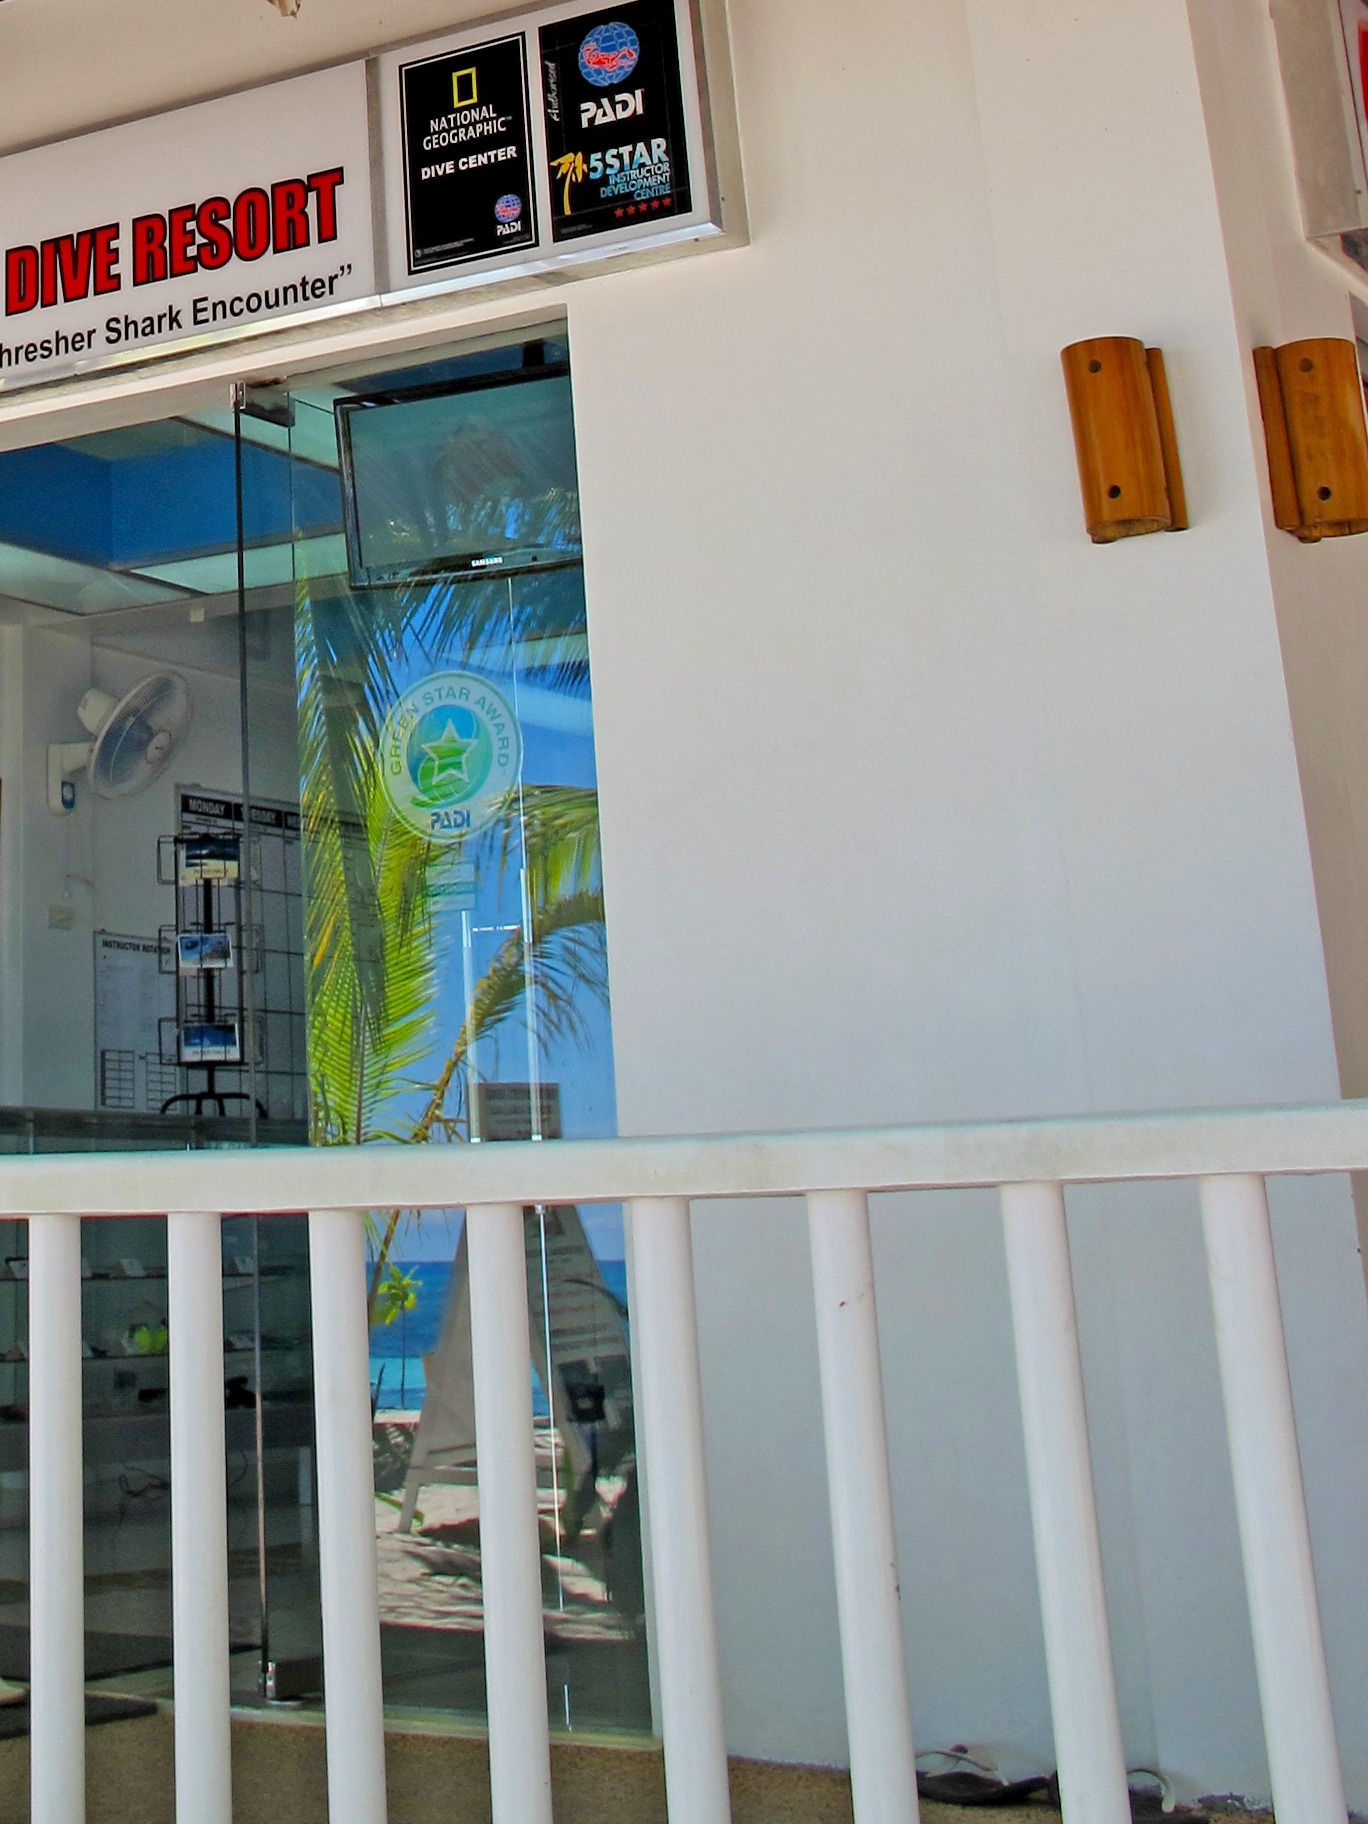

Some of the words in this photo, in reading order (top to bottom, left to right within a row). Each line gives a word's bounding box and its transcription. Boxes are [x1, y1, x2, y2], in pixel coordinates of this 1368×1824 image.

[429, 104, 497, 133] NATIONAL
[580, 88, 645, 128] PADI
[423, 115, 507, 151] GEOGRAPHIC
[421, 160, 455, 181] DIVE
[458, 145, 518, 171] CENTER
[588, 152, 604, 179] 5
[605, 137, 669, 175] STAR
[609, 162, 671, 185] INSTRUCTOR
[600, 173, 671, 198] DEVELOPMENT
[634, 182, 672, 201] CENTRE
[5, 222, 121, 316] DIVE
[131, 166, 345, 287] RESORT
[496, 220, 522, 237] PADI
[105, 302, 184, 346] Shark
[390, 702, 420, 776] GREEN
[422, 685, 471, 707] STAR
[474, 695, 510, 768] AWARD
[188, 798, 226, 817] MONDAY
[431, 809, 471, 830] PADI
